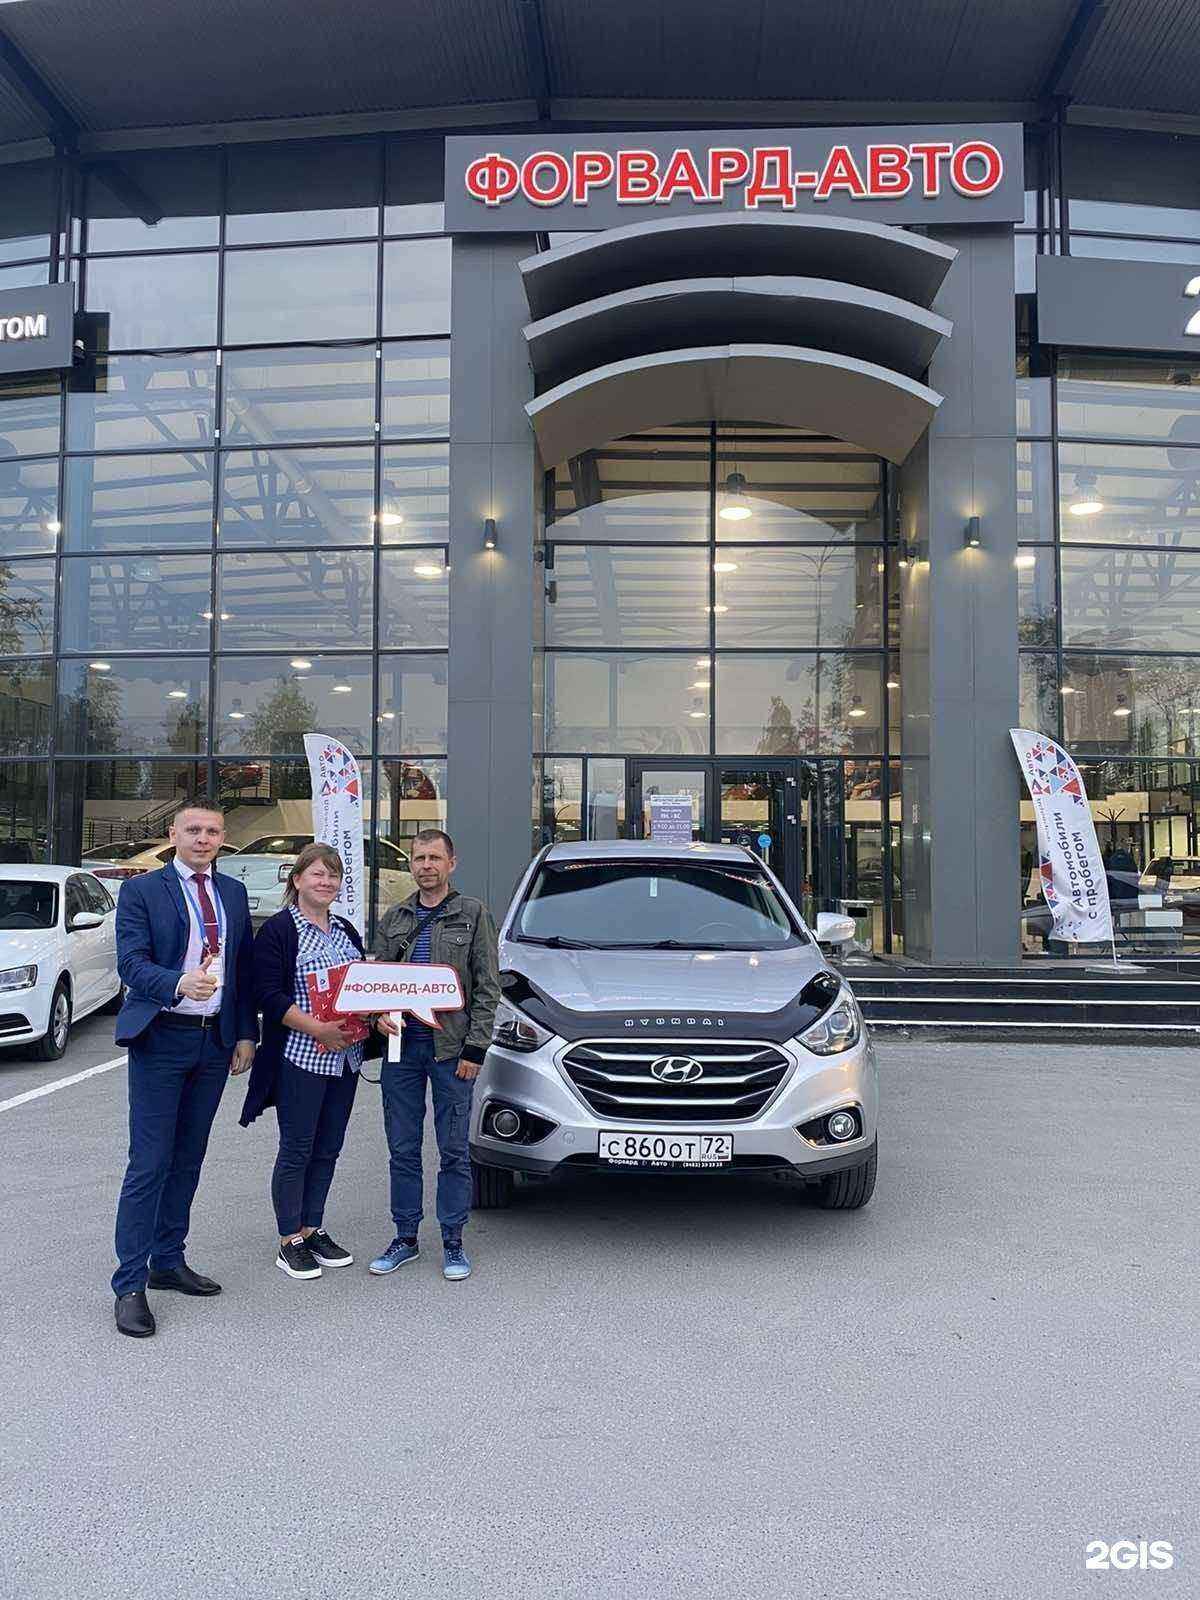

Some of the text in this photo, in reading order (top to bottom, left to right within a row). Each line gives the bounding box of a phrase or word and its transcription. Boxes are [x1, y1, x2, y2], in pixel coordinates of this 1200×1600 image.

[465, 140, 1002, 210] ФОРВАРД-АВТО
[343, 830, 355, 916] с пробегом
[1053, 812, 1084, 908] Автомобили
[1071, 831, 1098, 920] с пробегом
[344, 982, 457, 995] #ФОРВАРД-АВТО
